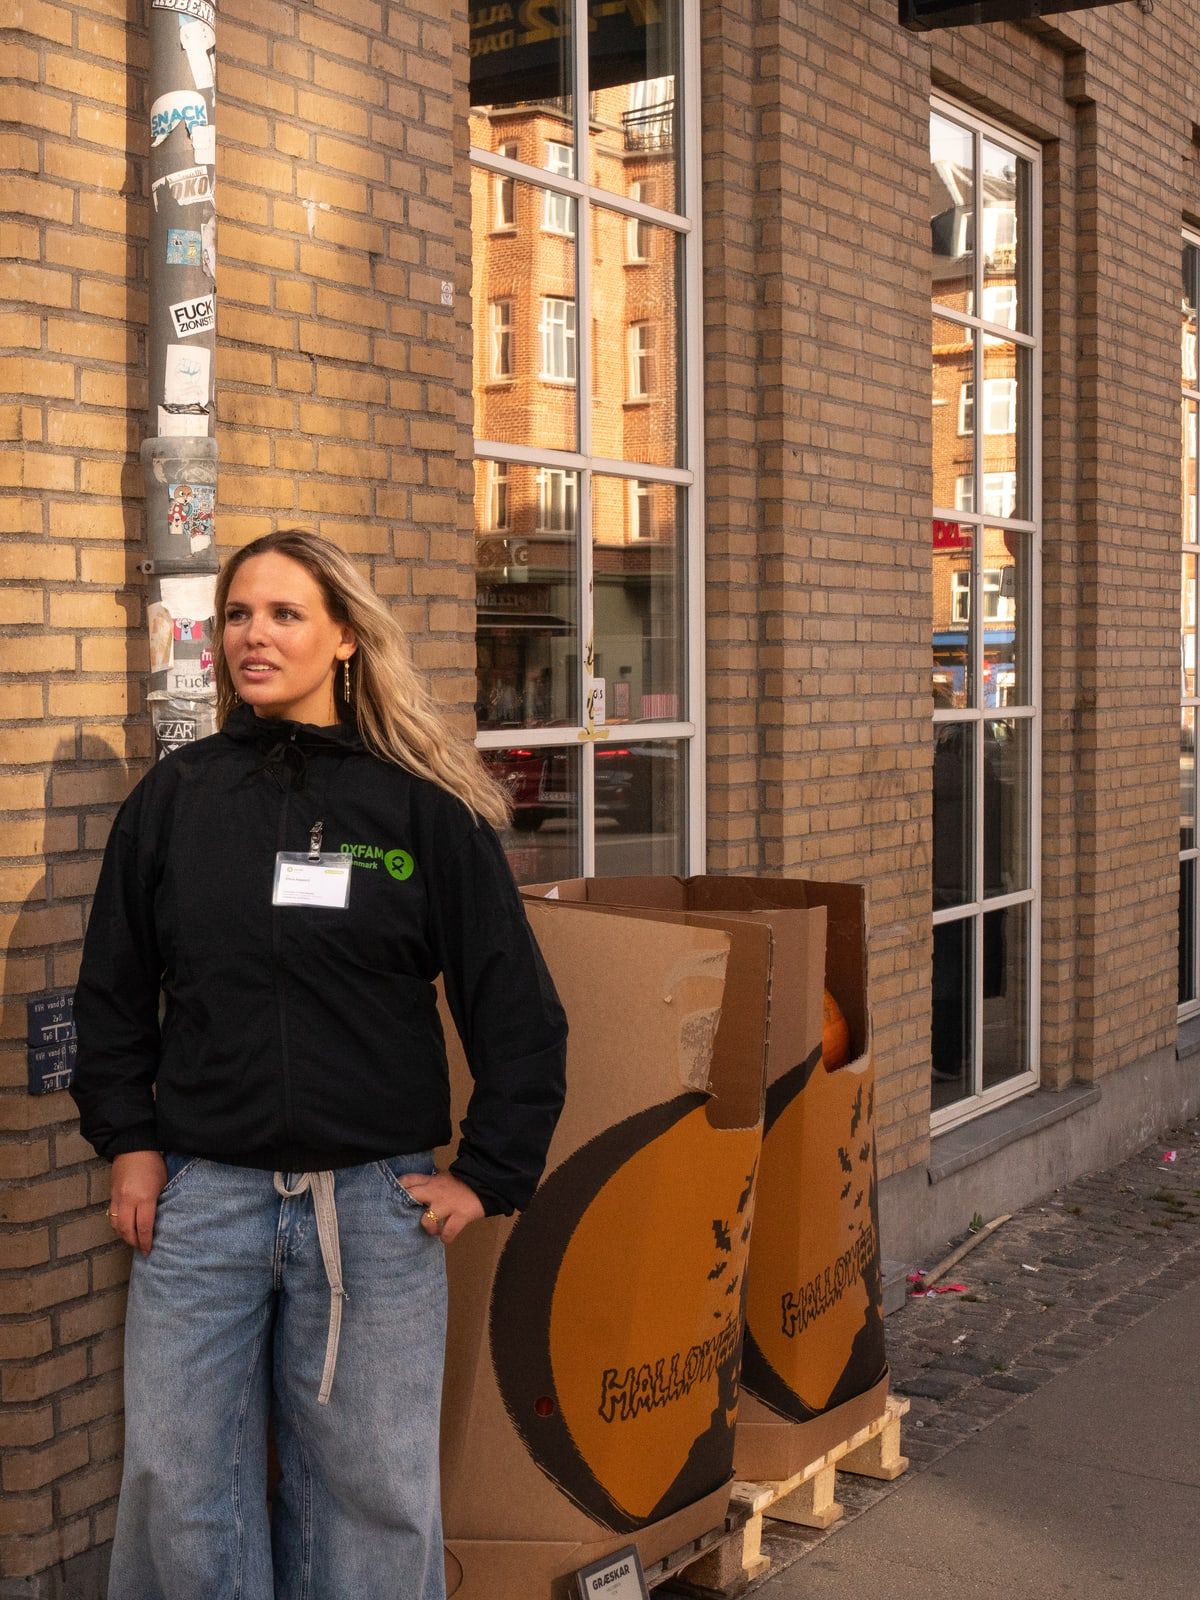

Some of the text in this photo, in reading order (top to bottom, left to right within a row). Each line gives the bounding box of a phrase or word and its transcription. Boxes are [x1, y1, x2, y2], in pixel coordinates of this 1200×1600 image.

[152, 105, 206, 131] SNACK
[174, 300, 214, 323] FUCK
[175, 675, 210, 689] Fuck
[157, 722, 193, 738] CZAR
[340, 843, 384, 860] OXFAM
[592, 1564, 631, 1591] GRÆSKAR
